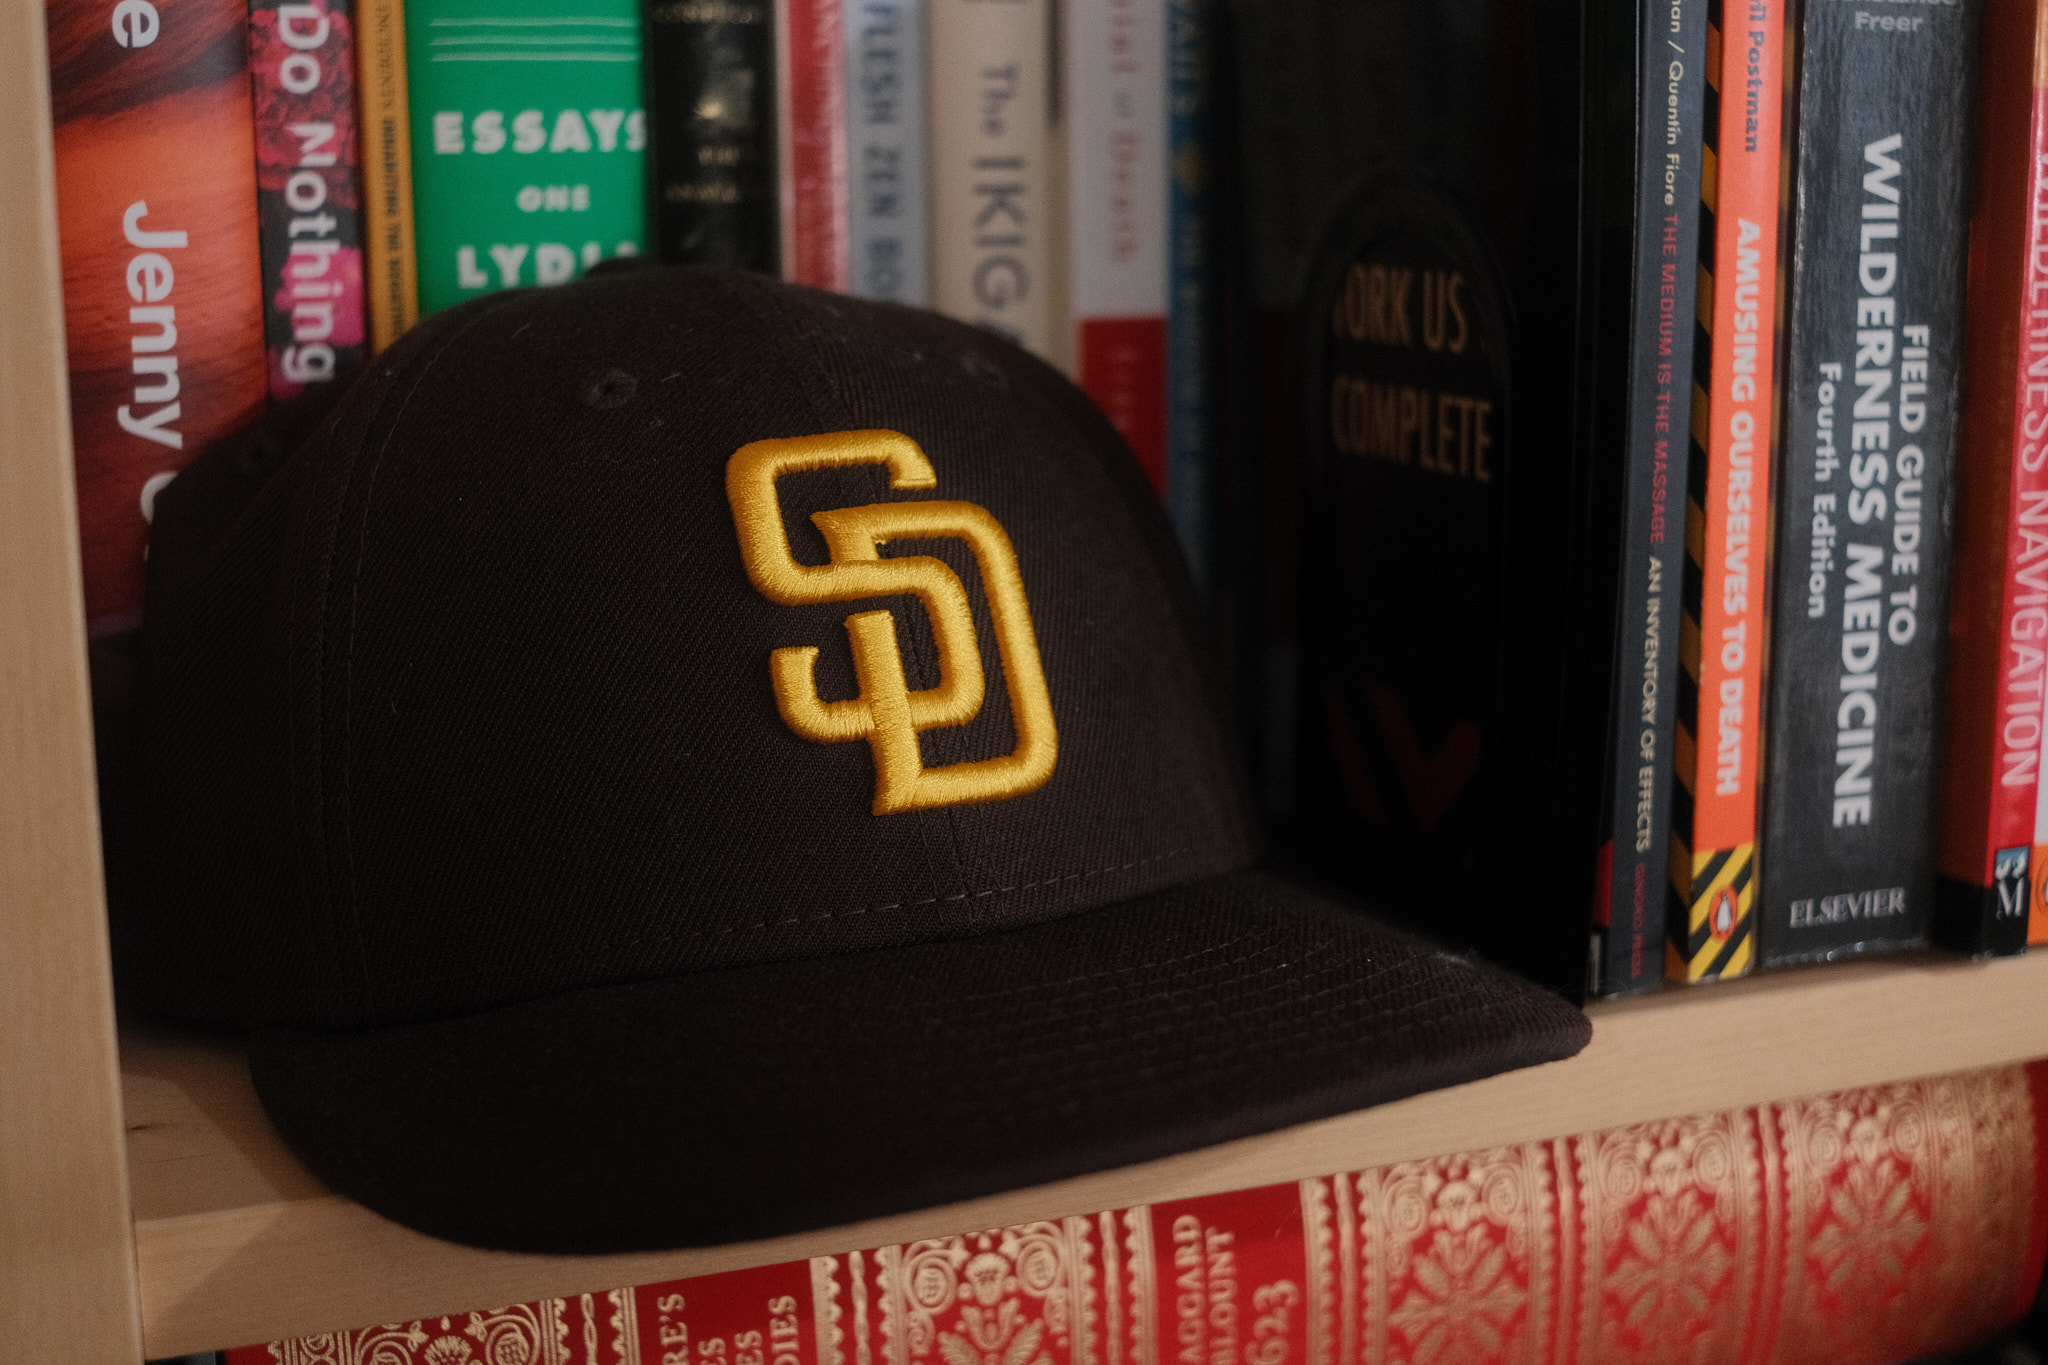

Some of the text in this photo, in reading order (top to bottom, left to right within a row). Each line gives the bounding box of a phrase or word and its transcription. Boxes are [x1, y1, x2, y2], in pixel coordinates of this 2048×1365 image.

[1854, 11, 1924, 33] Freer
[432, 109, 648, 155] ESSAYS
[981, 62, 1023, 138] The
[1667, 60, 1684, 146] Quentin
[1744, 30, 1766, 153] Postman
[278, 4, 342, 383] Do Nothing
[516, 184, 591, 213] ONE
[1664, 153, 1682, 206] Fiore
[457, 241, 640, 290] LYDI
[1422, 268, 1469, 353] US
[118, 201, 188, 450] Jenny
[1650, 214, 1679, 543] THE MEDIUM IS THE MASSAGE
[1331, 374, 1493, 483] COMPLETE
[1833, 133, 1902, 828] WILDERNESS MEDICINE
[1888, 325, 1929, 646] FIELD GUIDE TO
[1716, 218, 1761, 796] AMUSING OURSELVES TO DEATH
[1808, 362, 1841, 619] Fourth Edition
[2000, 491, 2048, 786] NAVIGATION
[1635, 556, 1664, 853] AN INVENTORY OF EFFECTS
[1789, 887, 1907, 928] ELSEVIER
